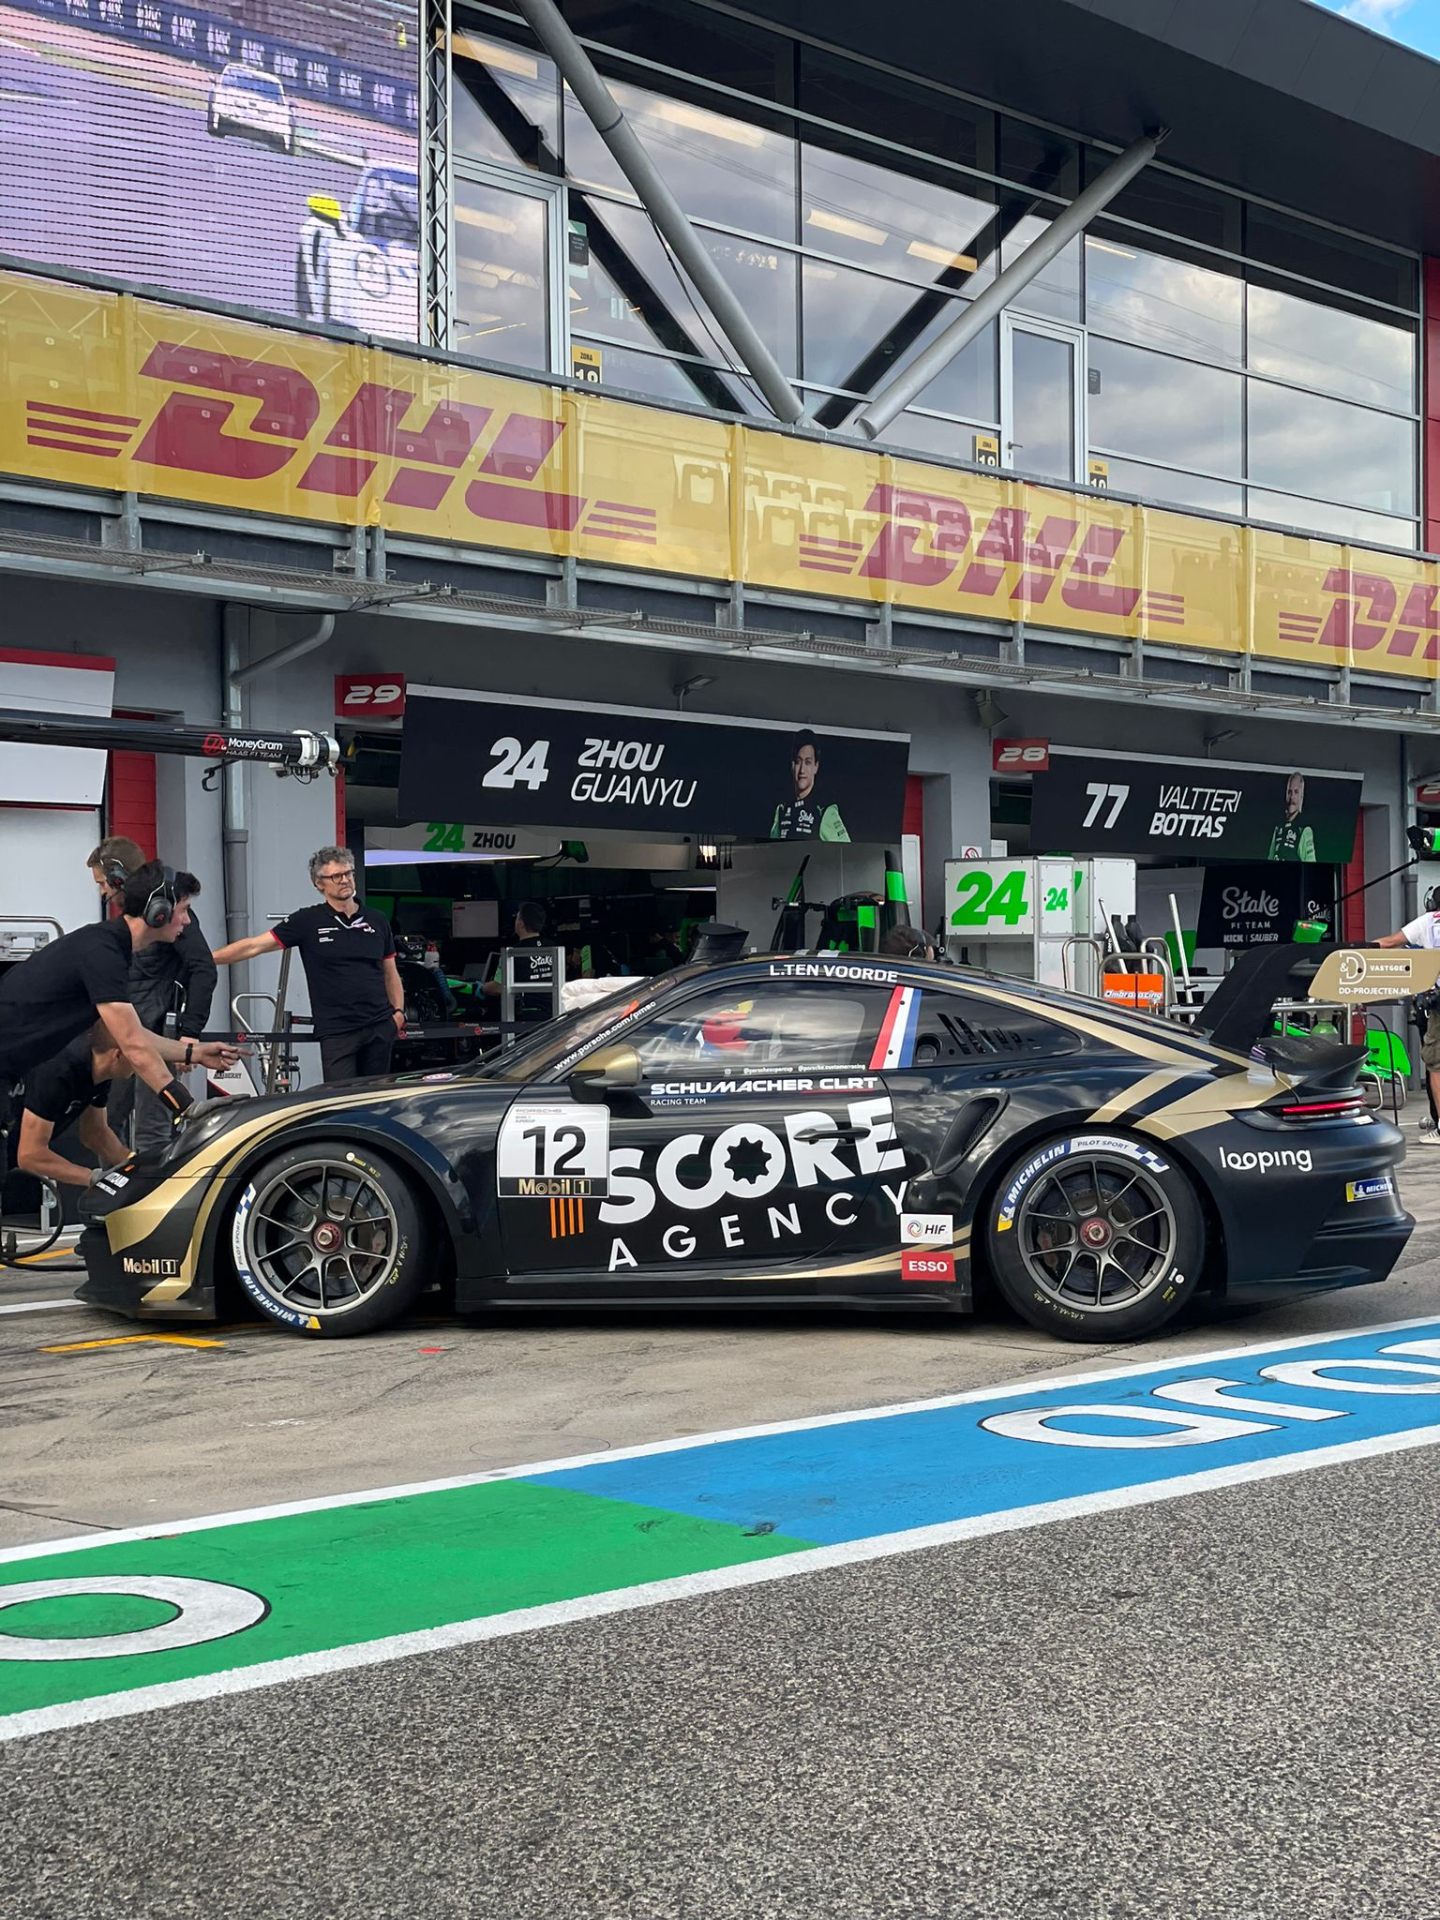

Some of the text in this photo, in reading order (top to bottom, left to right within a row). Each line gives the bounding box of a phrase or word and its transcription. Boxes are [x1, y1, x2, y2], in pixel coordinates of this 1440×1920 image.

[132, 341, 588, 531] DHL
[858, 483, 1142, 616] DHL
[344, 685, 401, 704] 29
[228, 737, 283, 750] MoneyGram
[578, 738, 665, 771] ZHOU
[999, 747, 1046, 762] 28
[482, 737, 549, 790] 24
[570, 772, 697, 807] GUANYU
[1159, 785, 1242, 812] VALTTERI
[1082, 783, 1130, 828] 77
[422, 822, 516, 852] 24 ZHOU
[1149, 812, 1227, 838] BOTTAS
[951, 871, 1028, 926] 24
[1045, 887, 1068, 911] 24
[1222, 886, 1280, 919] Stake
[1250, 934, 1279, 942] SAUBER
[824, 965, 900, 983] VOORDE
[1370, 964, 1407, 973] VASTGOE
[1338, 987, 1412, 995] DD-PROJECTEN.NL
[650, 1077, 878, 1095] SCHUMACHER CLRT
[650, 1098, 682, 1106] RACING
[523, 1125, 586, 1176] 12
[1077, 1139, 1130, 1150] PILOT SPORT
[598, 1096, 906, 1224] SCORE
[1219, 1146, 1313, 1174] looping
[518, 1178, 570, 1195] Mobil
[1007, 1144, 1065, 1204] MICHELIN
[608, 1180, 908, 1272] AGENCY
[924, 1224, 947, 1235] HIF
[123, 1257, 160, 1274] Mobil
[908, 1260, 948, 1272] ESSO
[242, 1275, 296, 1322] MICHELIN
